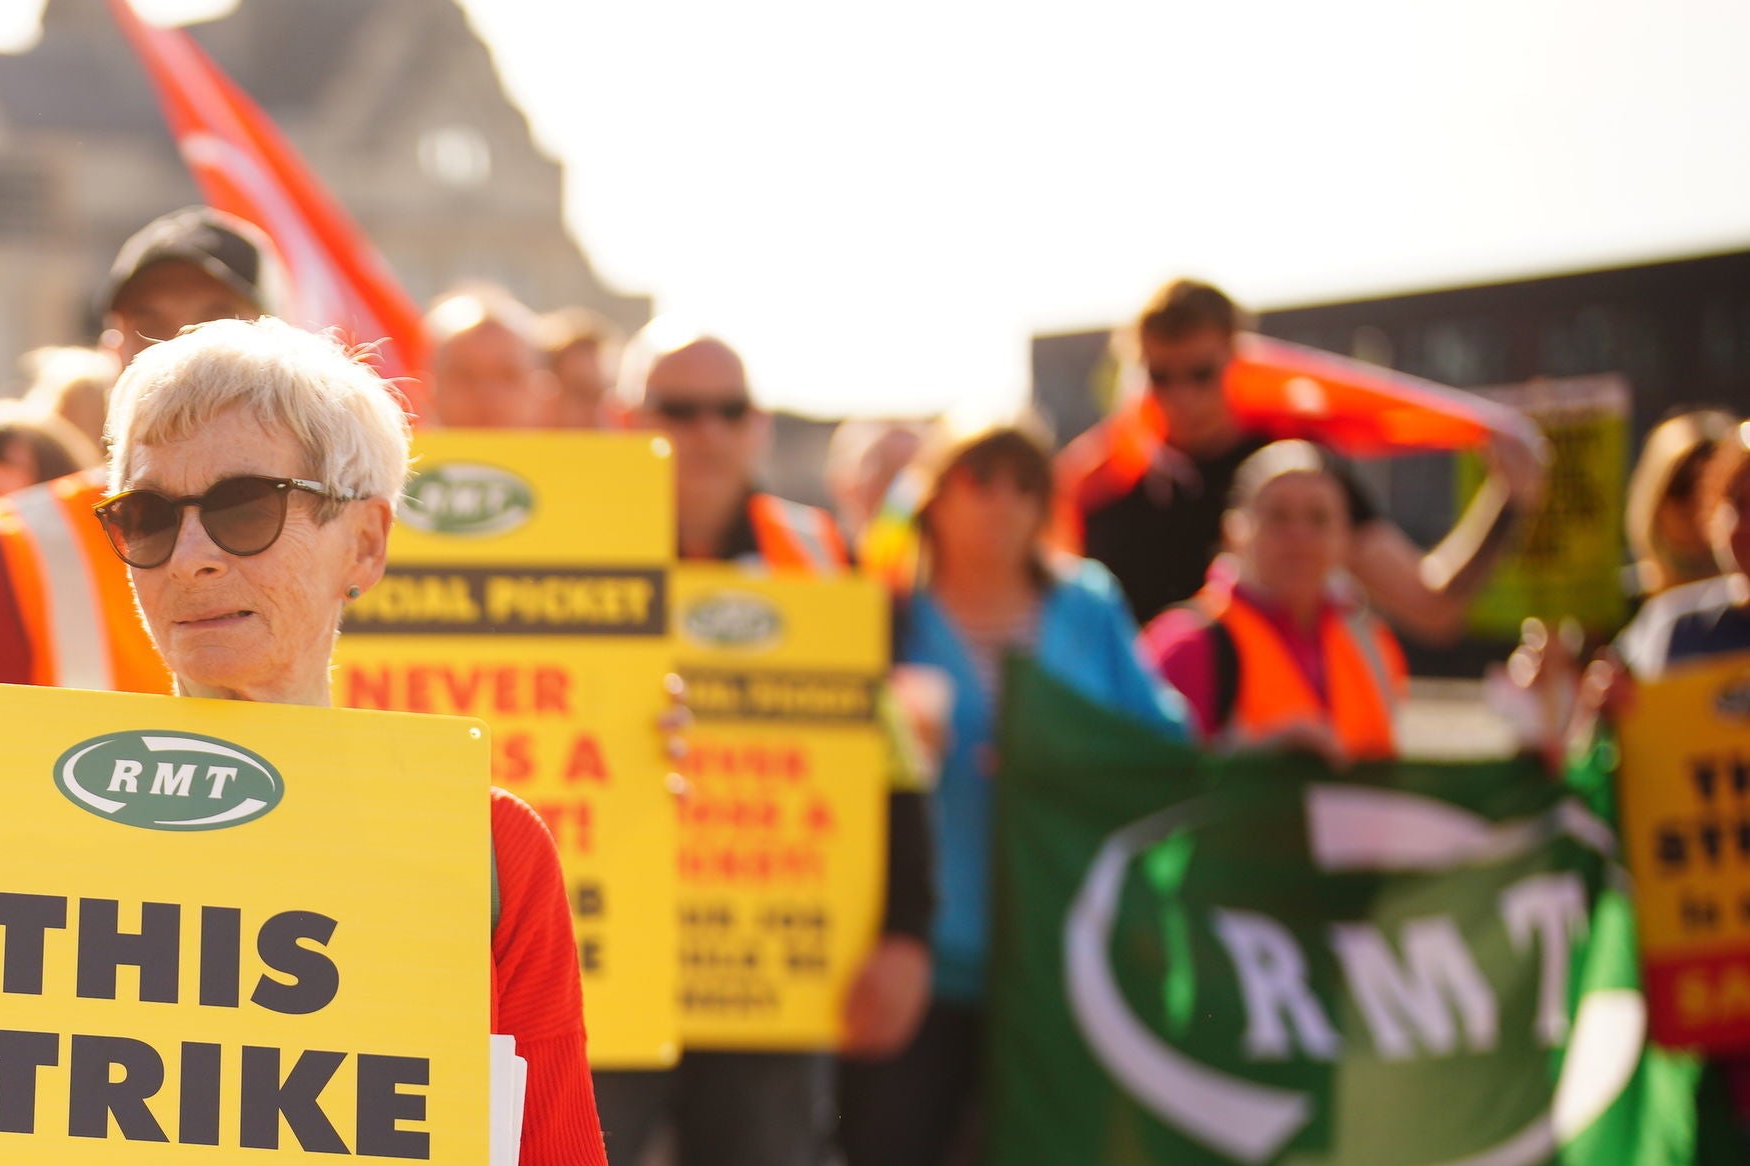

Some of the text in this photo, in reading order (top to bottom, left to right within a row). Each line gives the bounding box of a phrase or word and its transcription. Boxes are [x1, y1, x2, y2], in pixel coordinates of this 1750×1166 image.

[487, 576, 655, 625] PICKET
[348, 665, 574, 714] NEVER
[112, 756, 239, 800] RMT
[564, 737, 608, 783] A
[1215, 870, 1592, 1062] RMT
